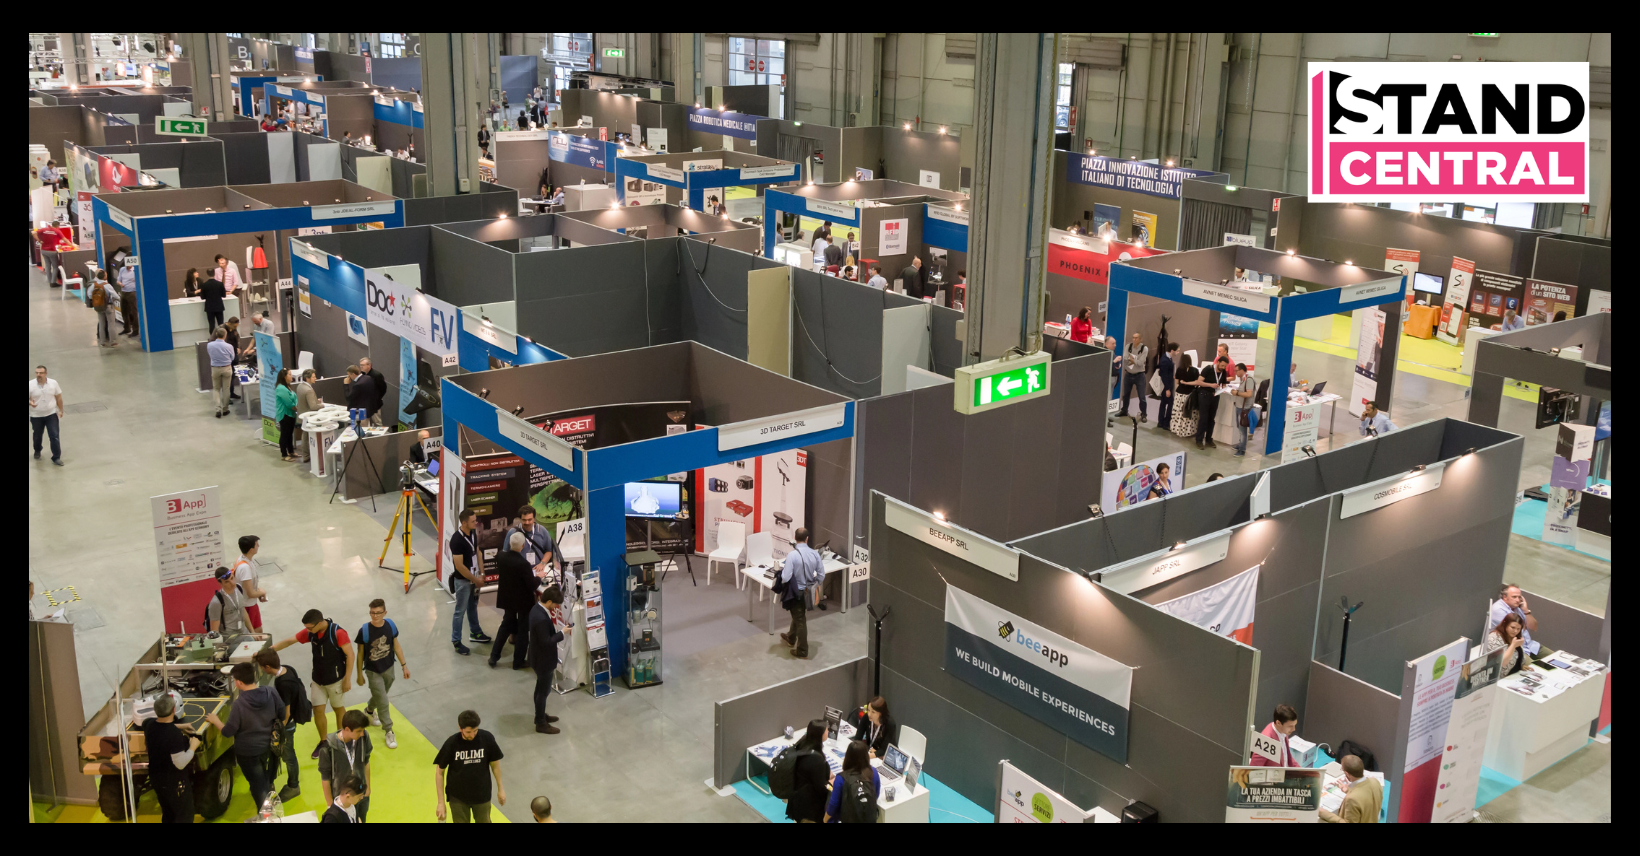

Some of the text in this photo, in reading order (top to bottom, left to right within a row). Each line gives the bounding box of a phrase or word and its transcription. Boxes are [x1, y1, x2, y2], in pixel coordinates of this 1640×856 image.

[237, 46, 248, 59] B
[689, 113, 703, 124] PIAZZA
[703, 116, 723, 128] ROBOTICA
[723, 119, 743, 131] MEDICALE
[1081, 157, 1107, 172] PIAZZA
[1108, 161, 1158, 180] INNOVAZIONE
[1081, 170, 1114, 186] ITALIANO
[1116, 175, 1125, 187] DI
[1127, 176, 1174, 196] TECNOLOGIA
[1060, 260, 1101, 276] PHOENIX
[1203, 289, 1248, 303] AVNET MEMEC SILICA
[1531, 282, 1566, 295] LA POTENZA
[430, 306, 454, 350] FV
[444, 356, 456, 364] A42
[551, 418, 592, 434] ARGET
[760, 427, 769, 435] 3D
[769, 422, 794, 433] TARGET
[794, 420, 806, 428] SRL
[426, 440, 441, 449] A40
[525, 433, 540, 446] TARGET
[540, 442, 548, 451] SRL
[1373, 485, 1402, 500] COSMOBILE
[183, 499, 204, 510] App
[567, 522, 583, 534] A38
[929, 527, 969, 551] BEEAPP SRL
[852, 567, 867, 578] A30
[1152, 564, 1168, 575] JAPP
[1169, 560, 1181, 569] SRL
[1016, 629, 1069, 668] beeapp
[955, 647, 1116, 736] WE BUILD MOBILE EXPERIENCES
[1254, 737, 1277, 756] A28
[455, 748, 485, 761] POLIMI
[1241, 787, 1312, 798] LA TUA AZIENDA IN TASCA
[1246, 795, 1251, 803] A
[1271, 796, 1305, 805] IMBATTIBILI
[1033, 803, 1051, 820] SERVIZI
